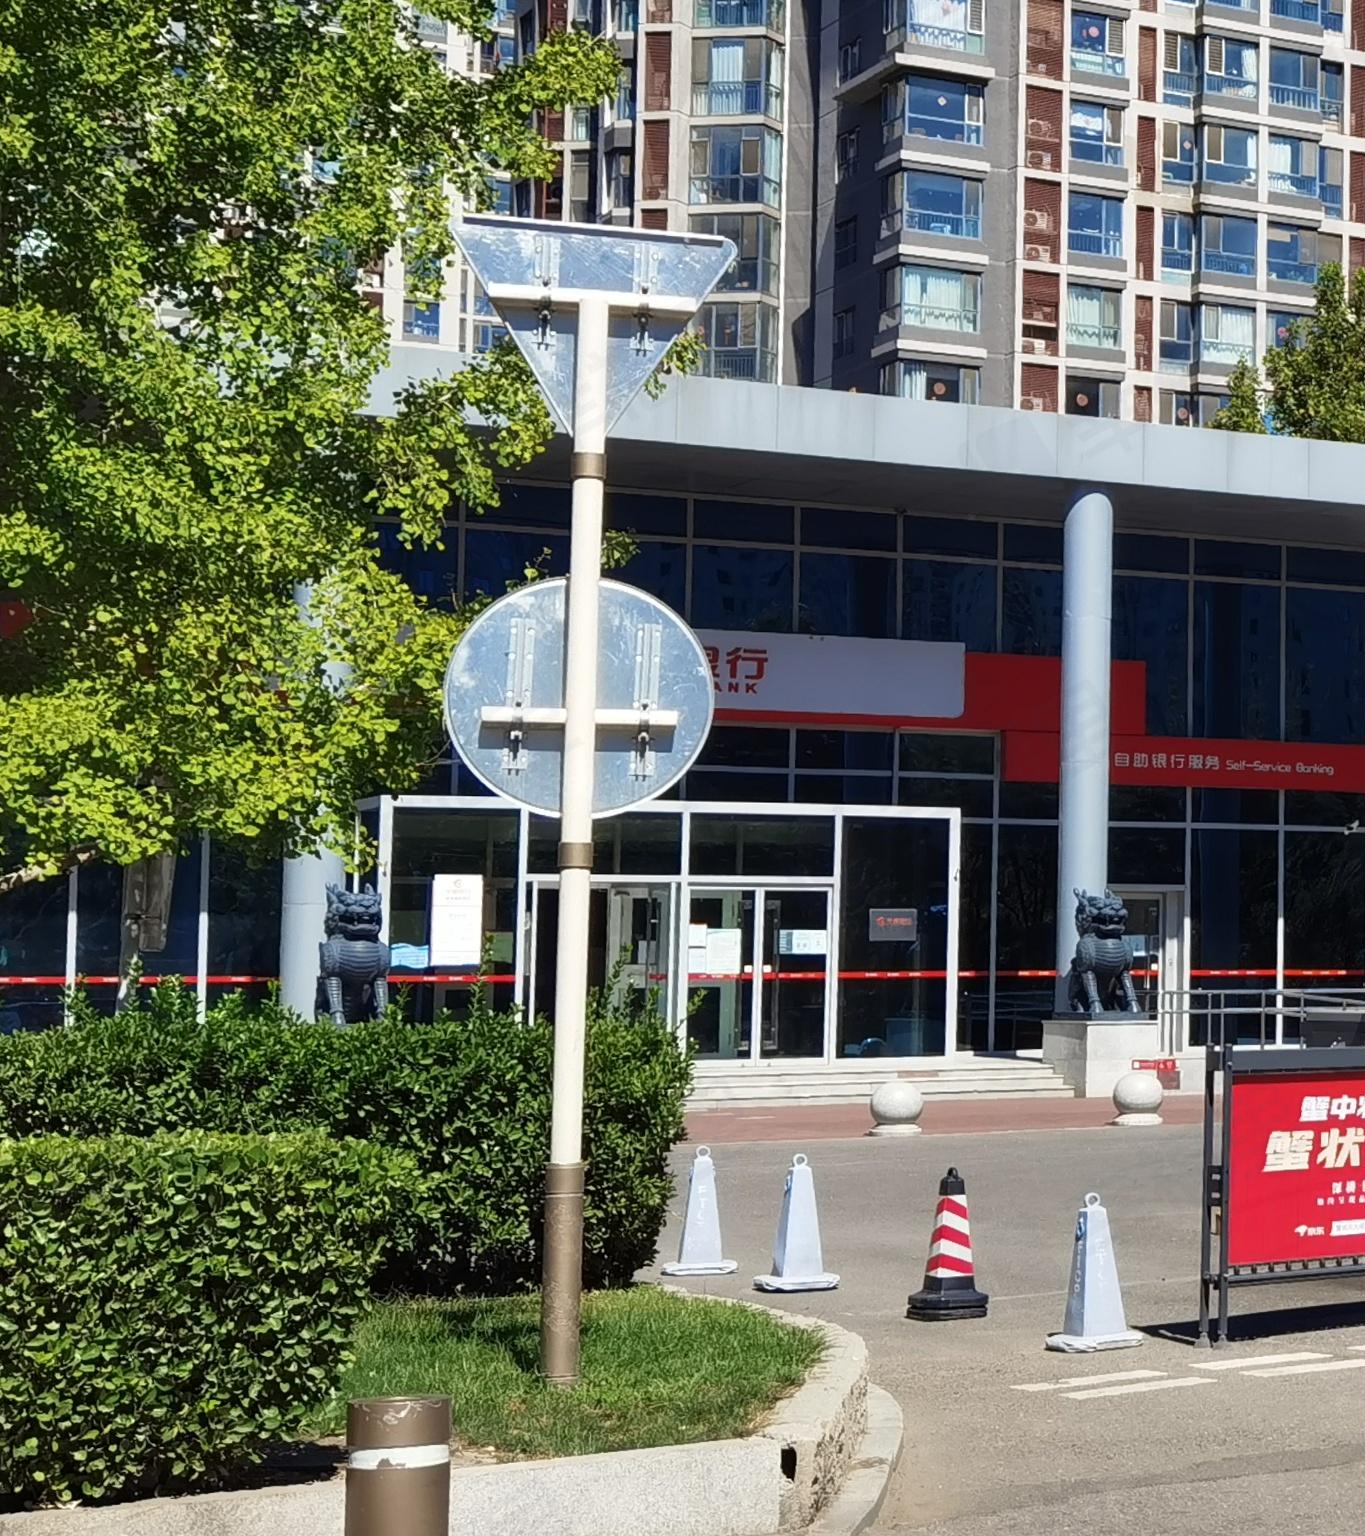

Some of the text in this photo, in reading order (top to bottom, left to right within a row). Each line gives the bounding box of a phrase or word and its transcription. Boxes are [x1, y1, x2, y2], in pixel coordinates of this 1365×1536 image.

[1114, 752, 1335, 776] 自助银行服务 Self-Service Banking
